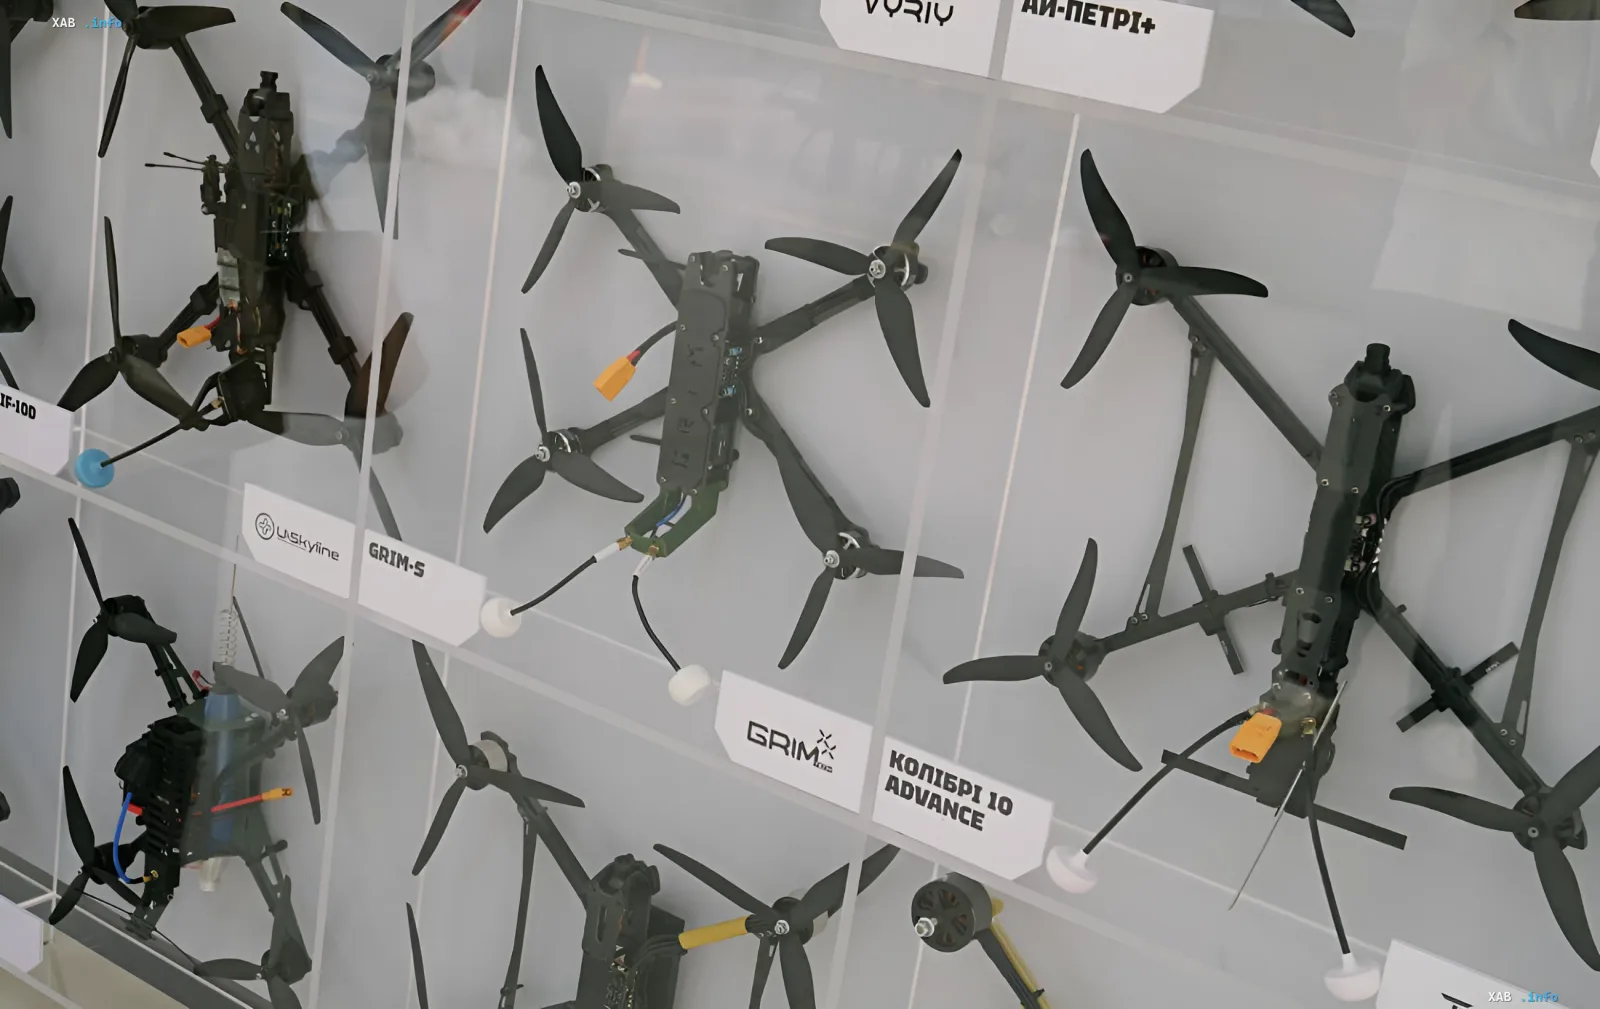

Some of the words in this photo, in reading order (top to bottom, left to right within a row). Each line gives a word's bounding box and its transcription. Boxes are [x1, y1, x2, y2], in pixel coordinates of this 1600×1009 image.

[746, 720, 820, 766] GRIM
[884, 774, 986, 832] ADVANCE
[889, 749, 983, 805] КОЛІБРІ
[987, 791, 1014, 817] 10
